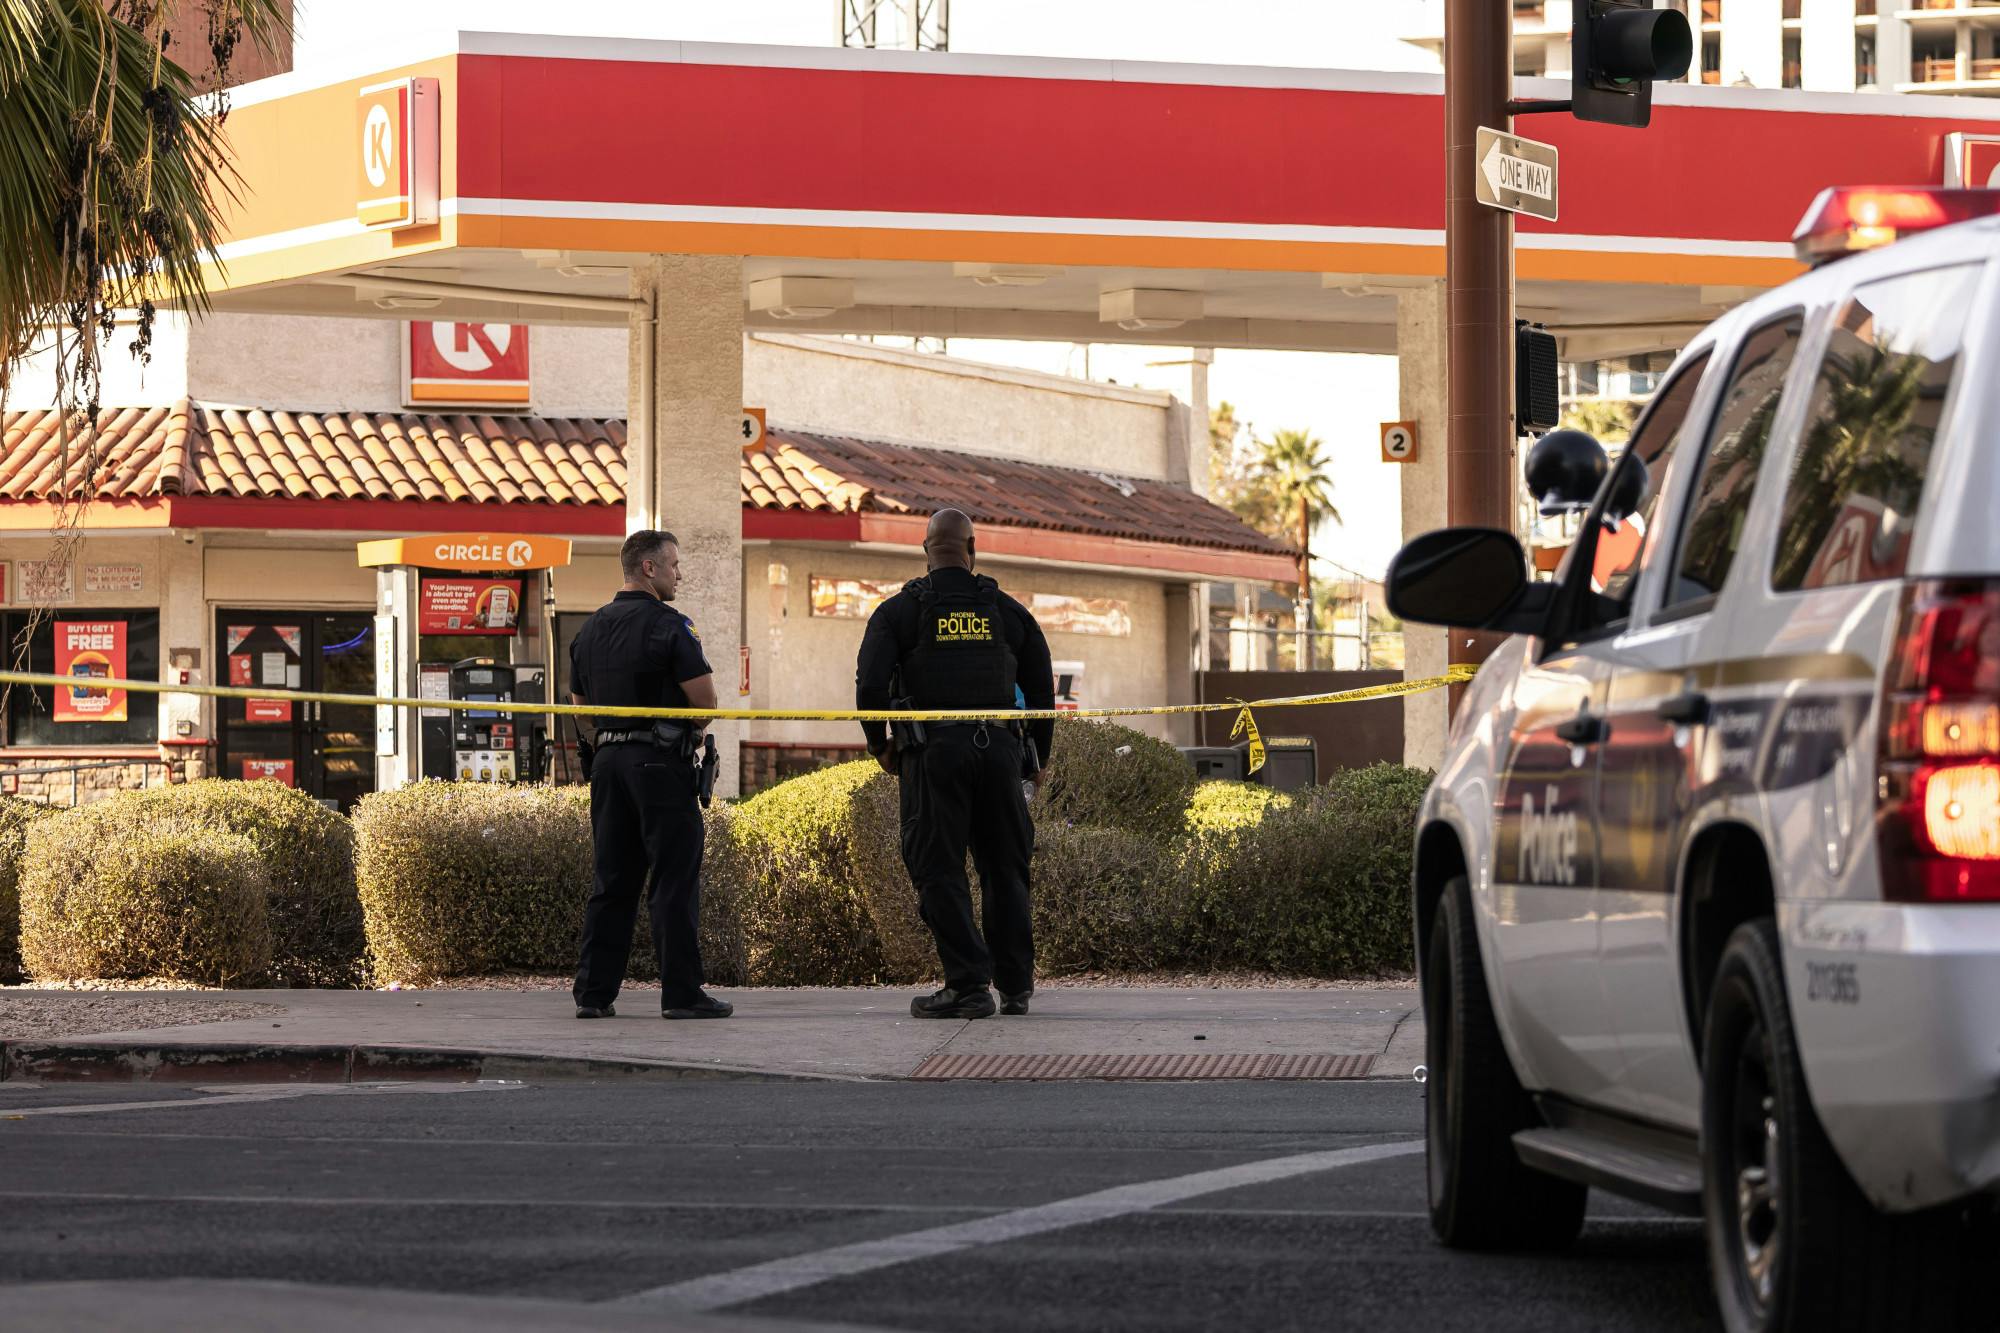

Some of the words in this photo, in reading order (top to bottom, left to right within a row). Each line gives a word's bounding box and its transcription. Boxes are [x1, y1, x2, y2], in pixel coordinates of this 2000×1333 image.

[367, 113, 390, 184] K
[1500, 157, 1522, 189] ONE
[1526, 165, 1549, 195] WAY
[742, 419, 752, 438] 4
[1392, 433, 1405, 451] 2
[434, 544, 503, 561] CIRCLE
[510, 543, 530, 566] K
[446, 584, 474, 592] journey
[67, 625, 85, 633] BUY
[91, 625, 109, 633] GET
[938, 618, 990, 634] POLICE
[67, 634, 114, 650] FREE
[1518, 784, 1578, 884] Police
